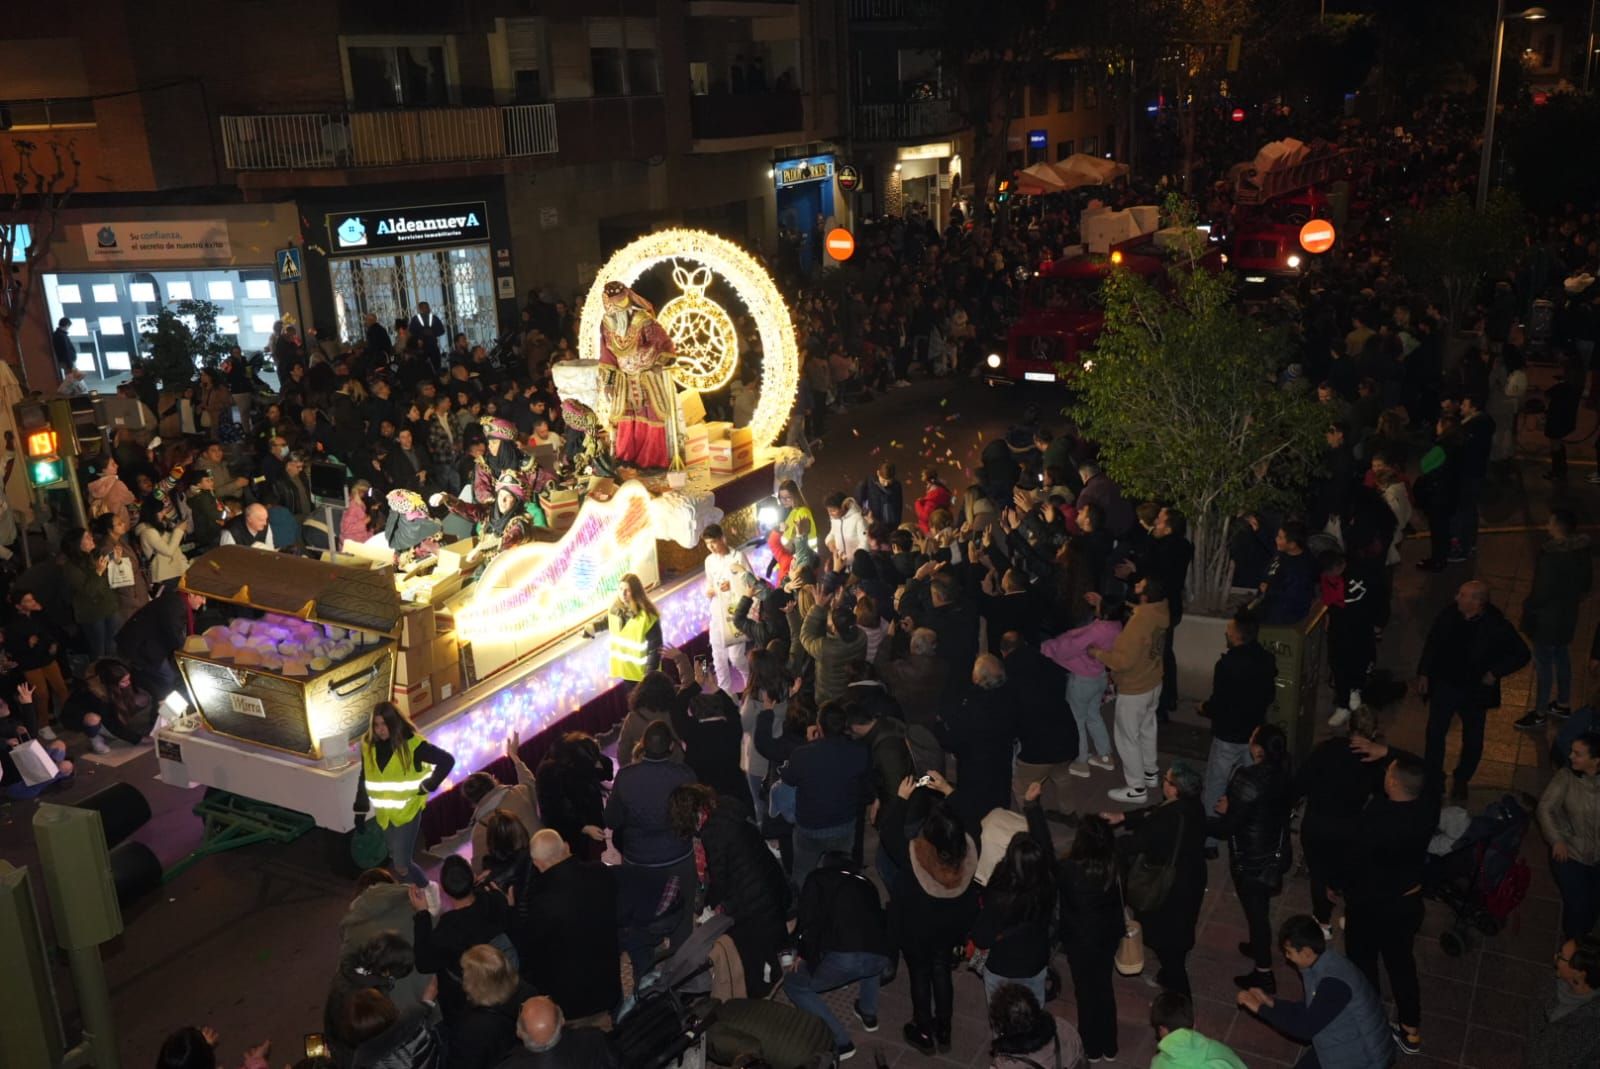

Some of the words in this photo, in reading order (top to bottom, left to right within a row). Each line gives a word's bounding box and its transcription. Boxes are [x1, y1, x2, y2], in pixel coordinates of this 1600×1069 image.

[377, 213, 479, 234] AldeanuevA
[139, 242, 164, 250] secreto
[165, 241, 175, 249] de
[176, 240, 203, 249] nuestro
